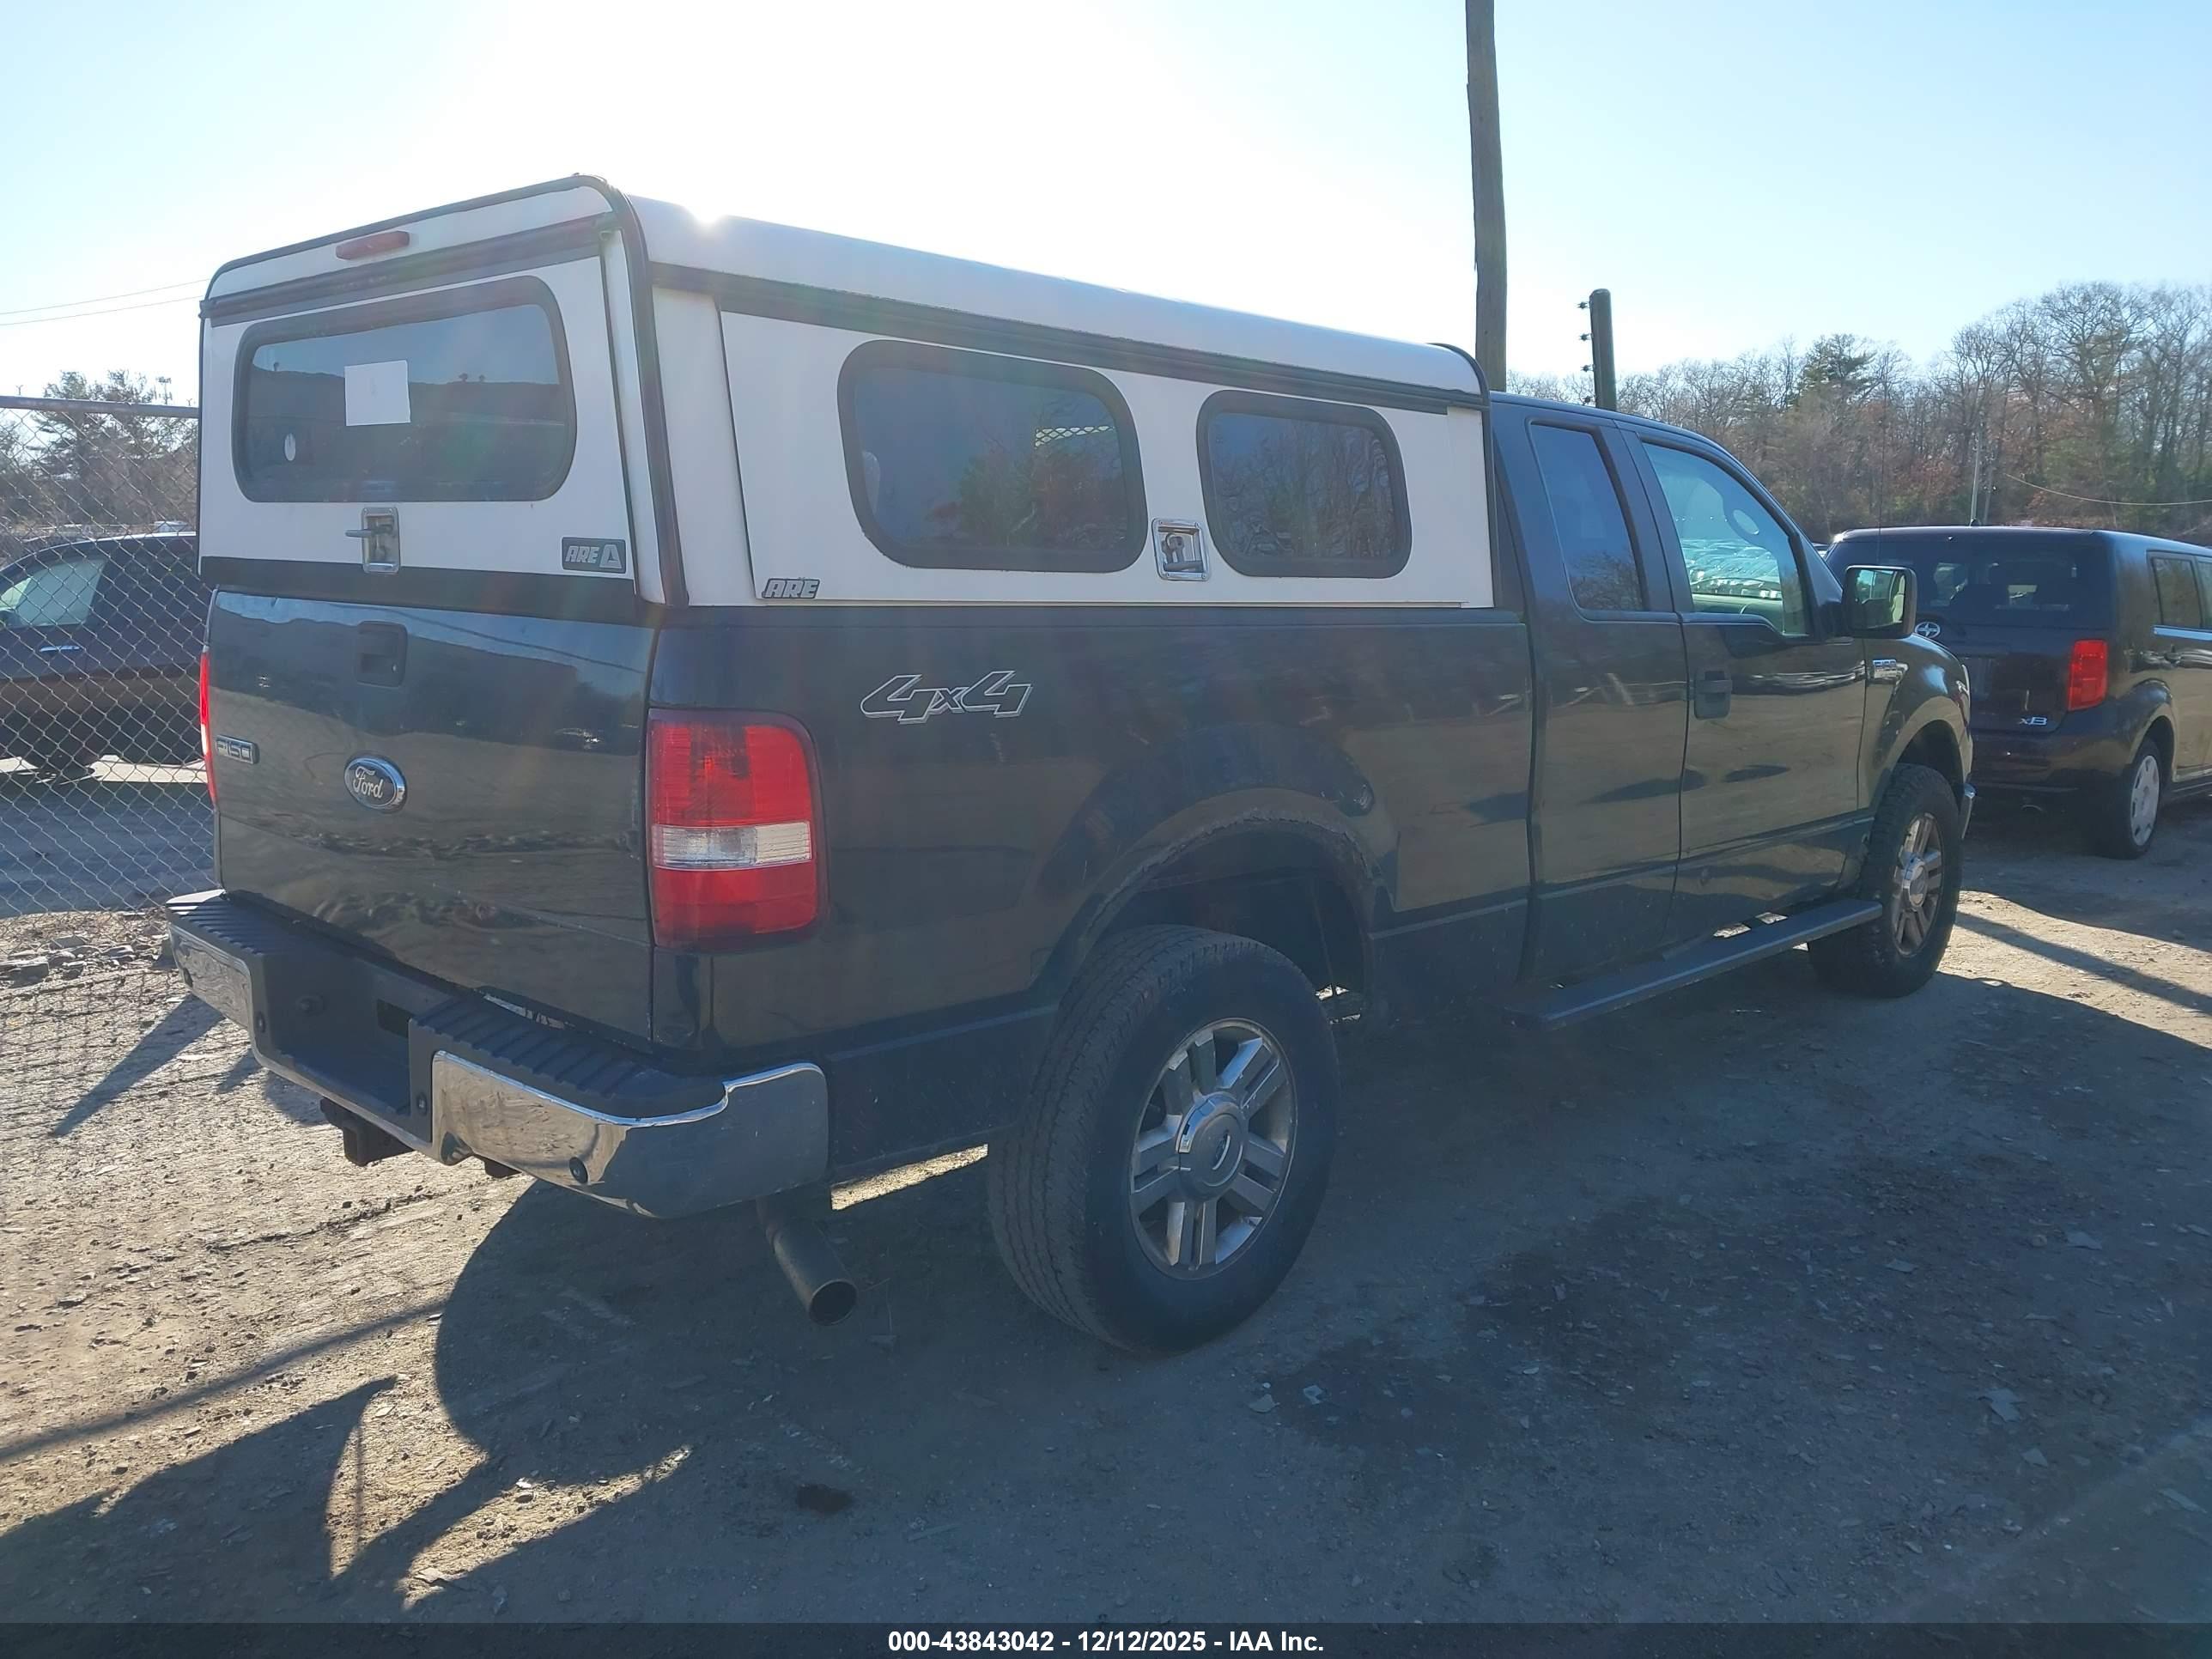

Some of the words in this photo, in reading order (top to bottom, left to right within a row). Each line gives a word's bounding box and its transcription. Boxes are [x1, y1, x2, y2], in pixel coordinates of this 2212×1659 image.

[763, 578, 820, 599] ARE
[860, 670, 1033, 724] 4x4
[2019, 716, 2047, 726] xB
[353, 766, 384, 799] Ford
